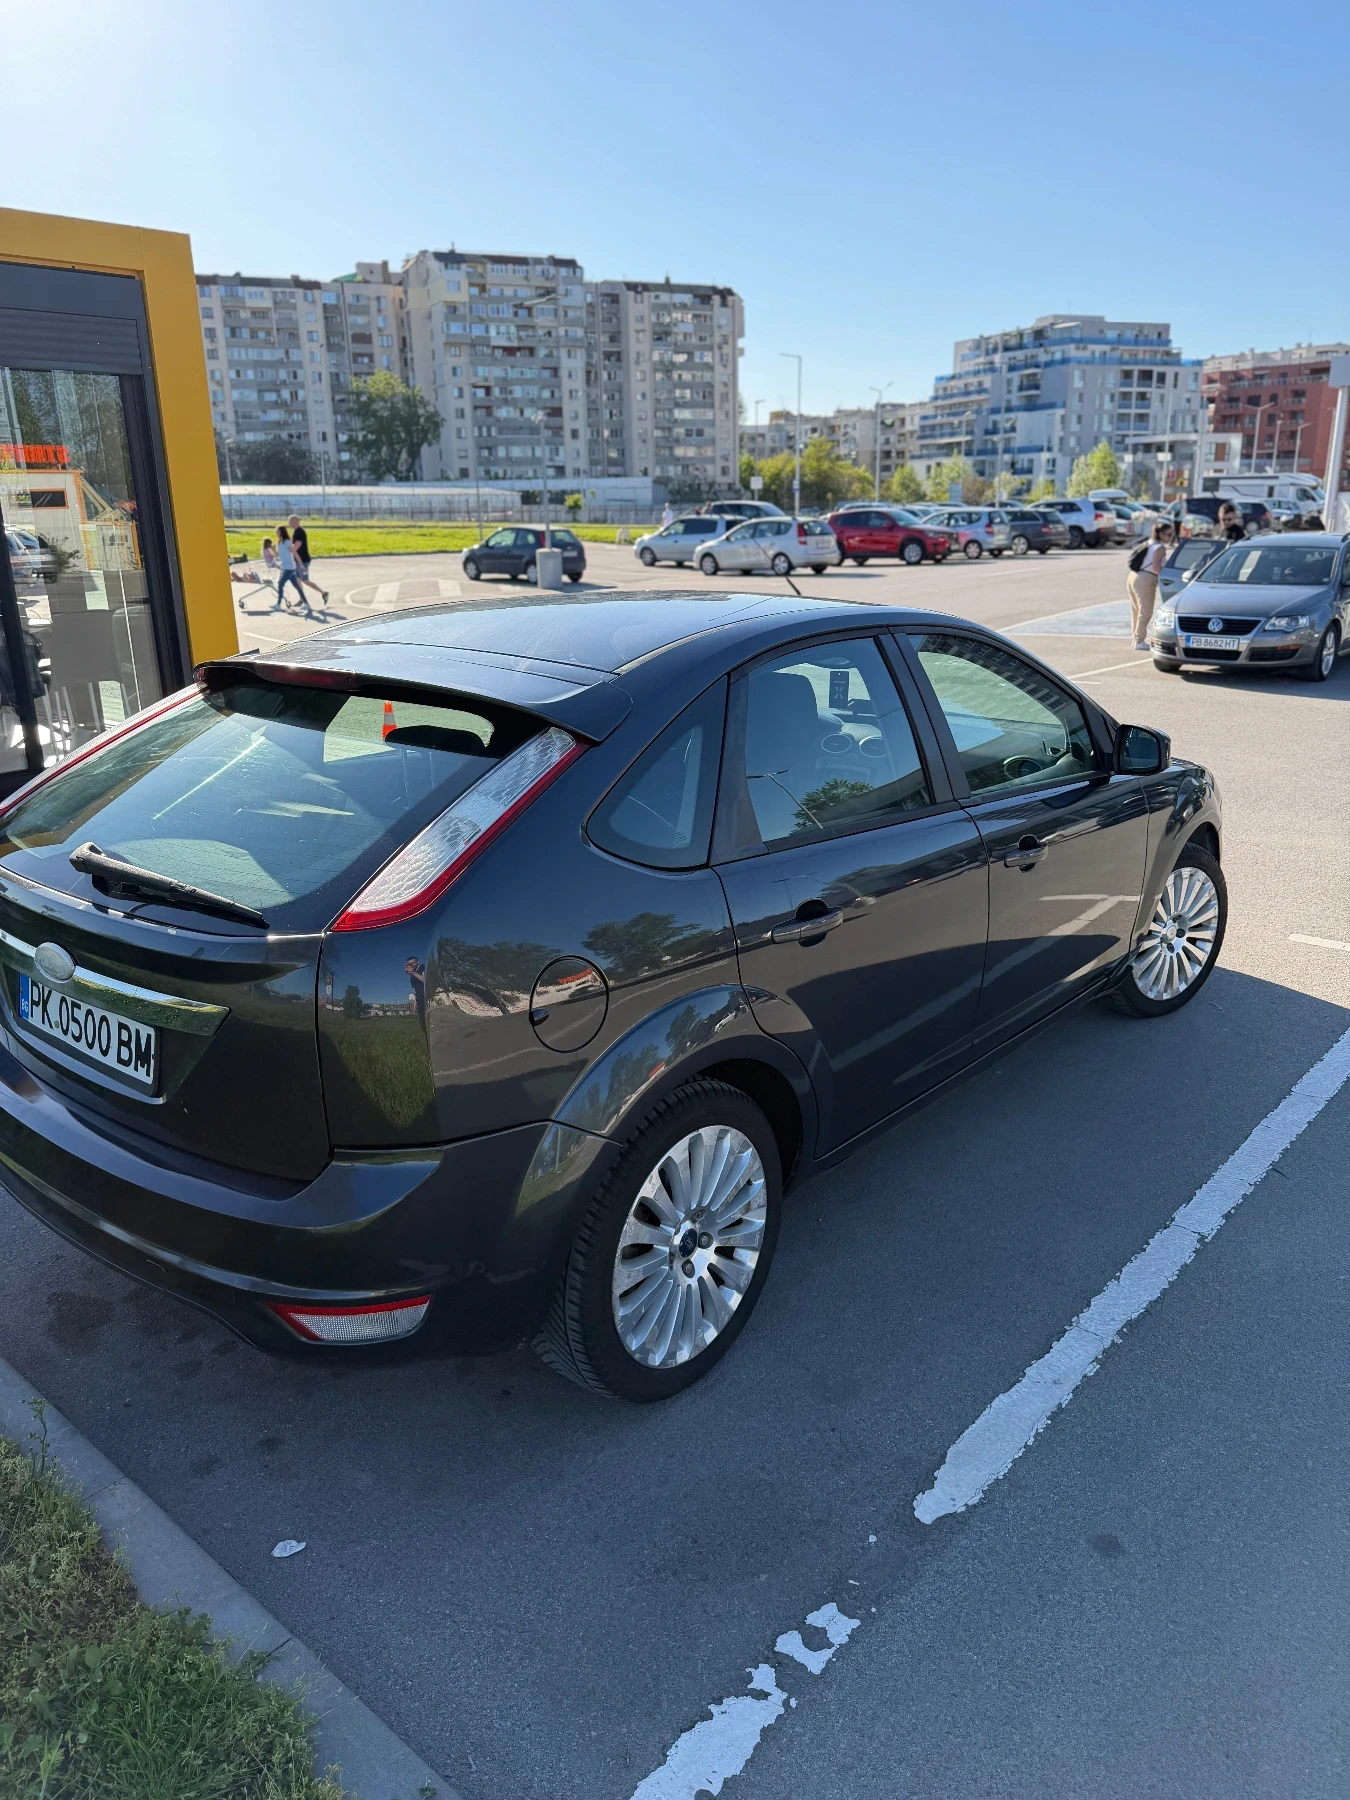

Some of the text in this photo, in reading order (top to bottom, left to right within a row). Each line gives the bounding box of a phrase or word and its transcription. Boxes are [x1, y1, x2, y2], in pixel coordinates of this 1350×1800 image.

[1191, 637, 1237, 648] PB 8682 HT
[21, 998, 29, 1013] BG
[30, 980, 152, 1078] PK 0500 BM
